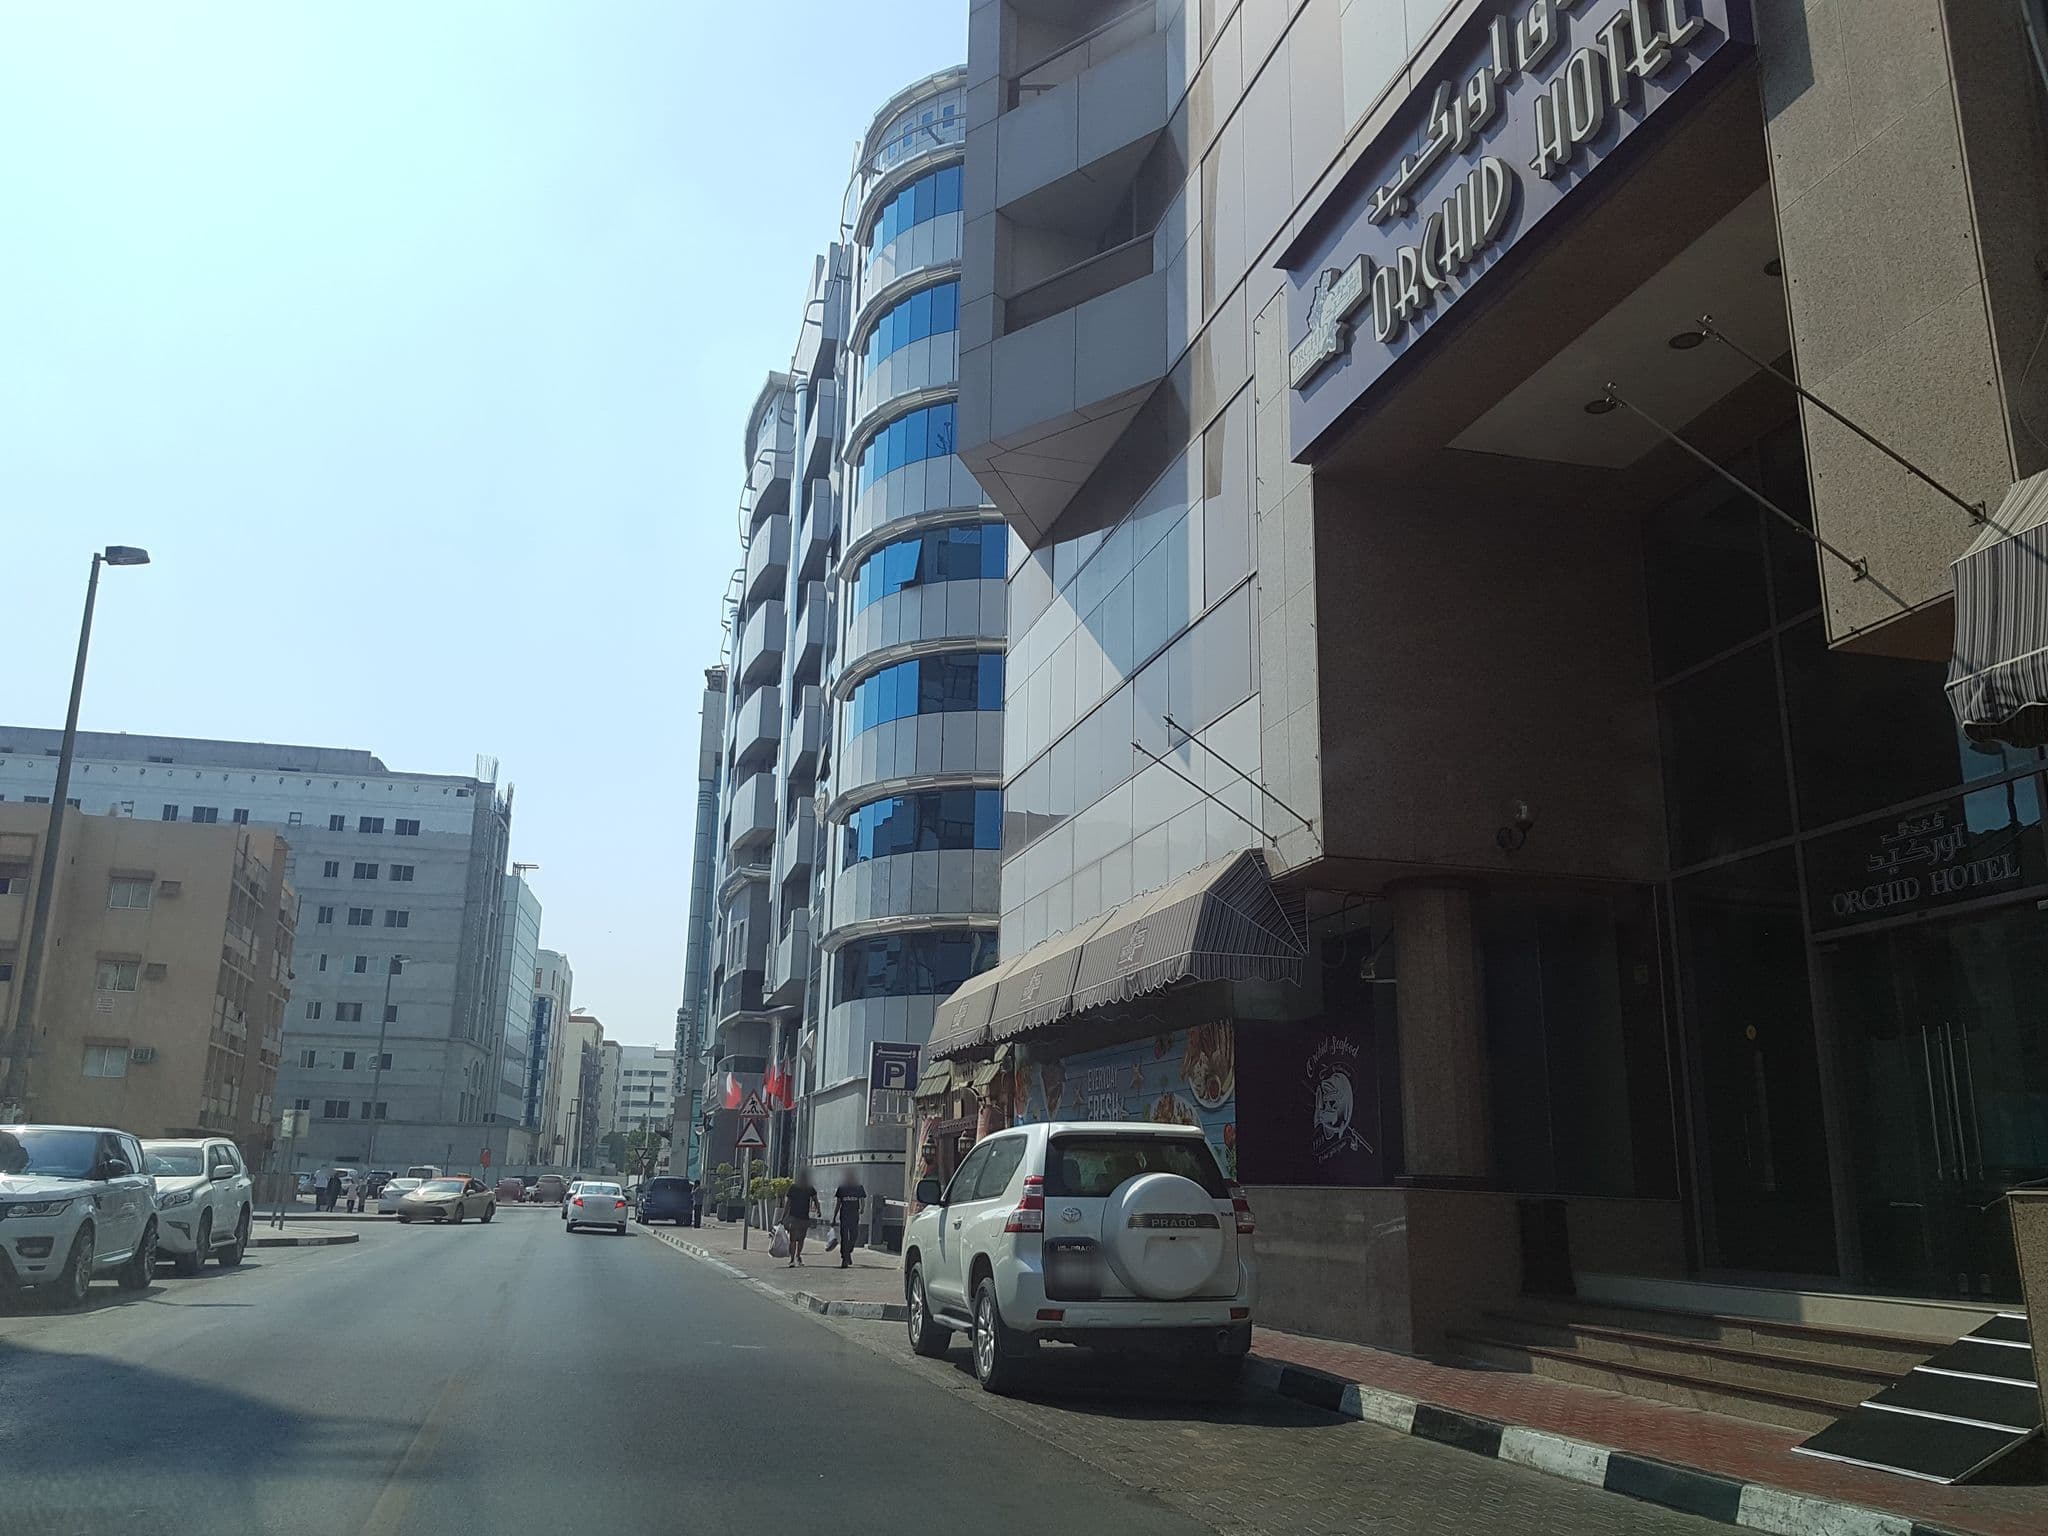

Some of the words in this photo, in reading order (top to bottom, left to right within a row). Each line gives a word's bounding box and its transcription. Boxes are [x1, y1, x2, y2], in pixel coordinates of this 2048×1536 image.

[1372, 155, 1513, 343] ORCHID
[1832, 877, 1921, 914] ORCHID
[1929, 853, 2022, 896] HOTEL
[884, 1063, 905, 1086] P
[1087, 1092, 1119, 1121] FRESH
[1151, 1217, 1197, 1229] PRADO
